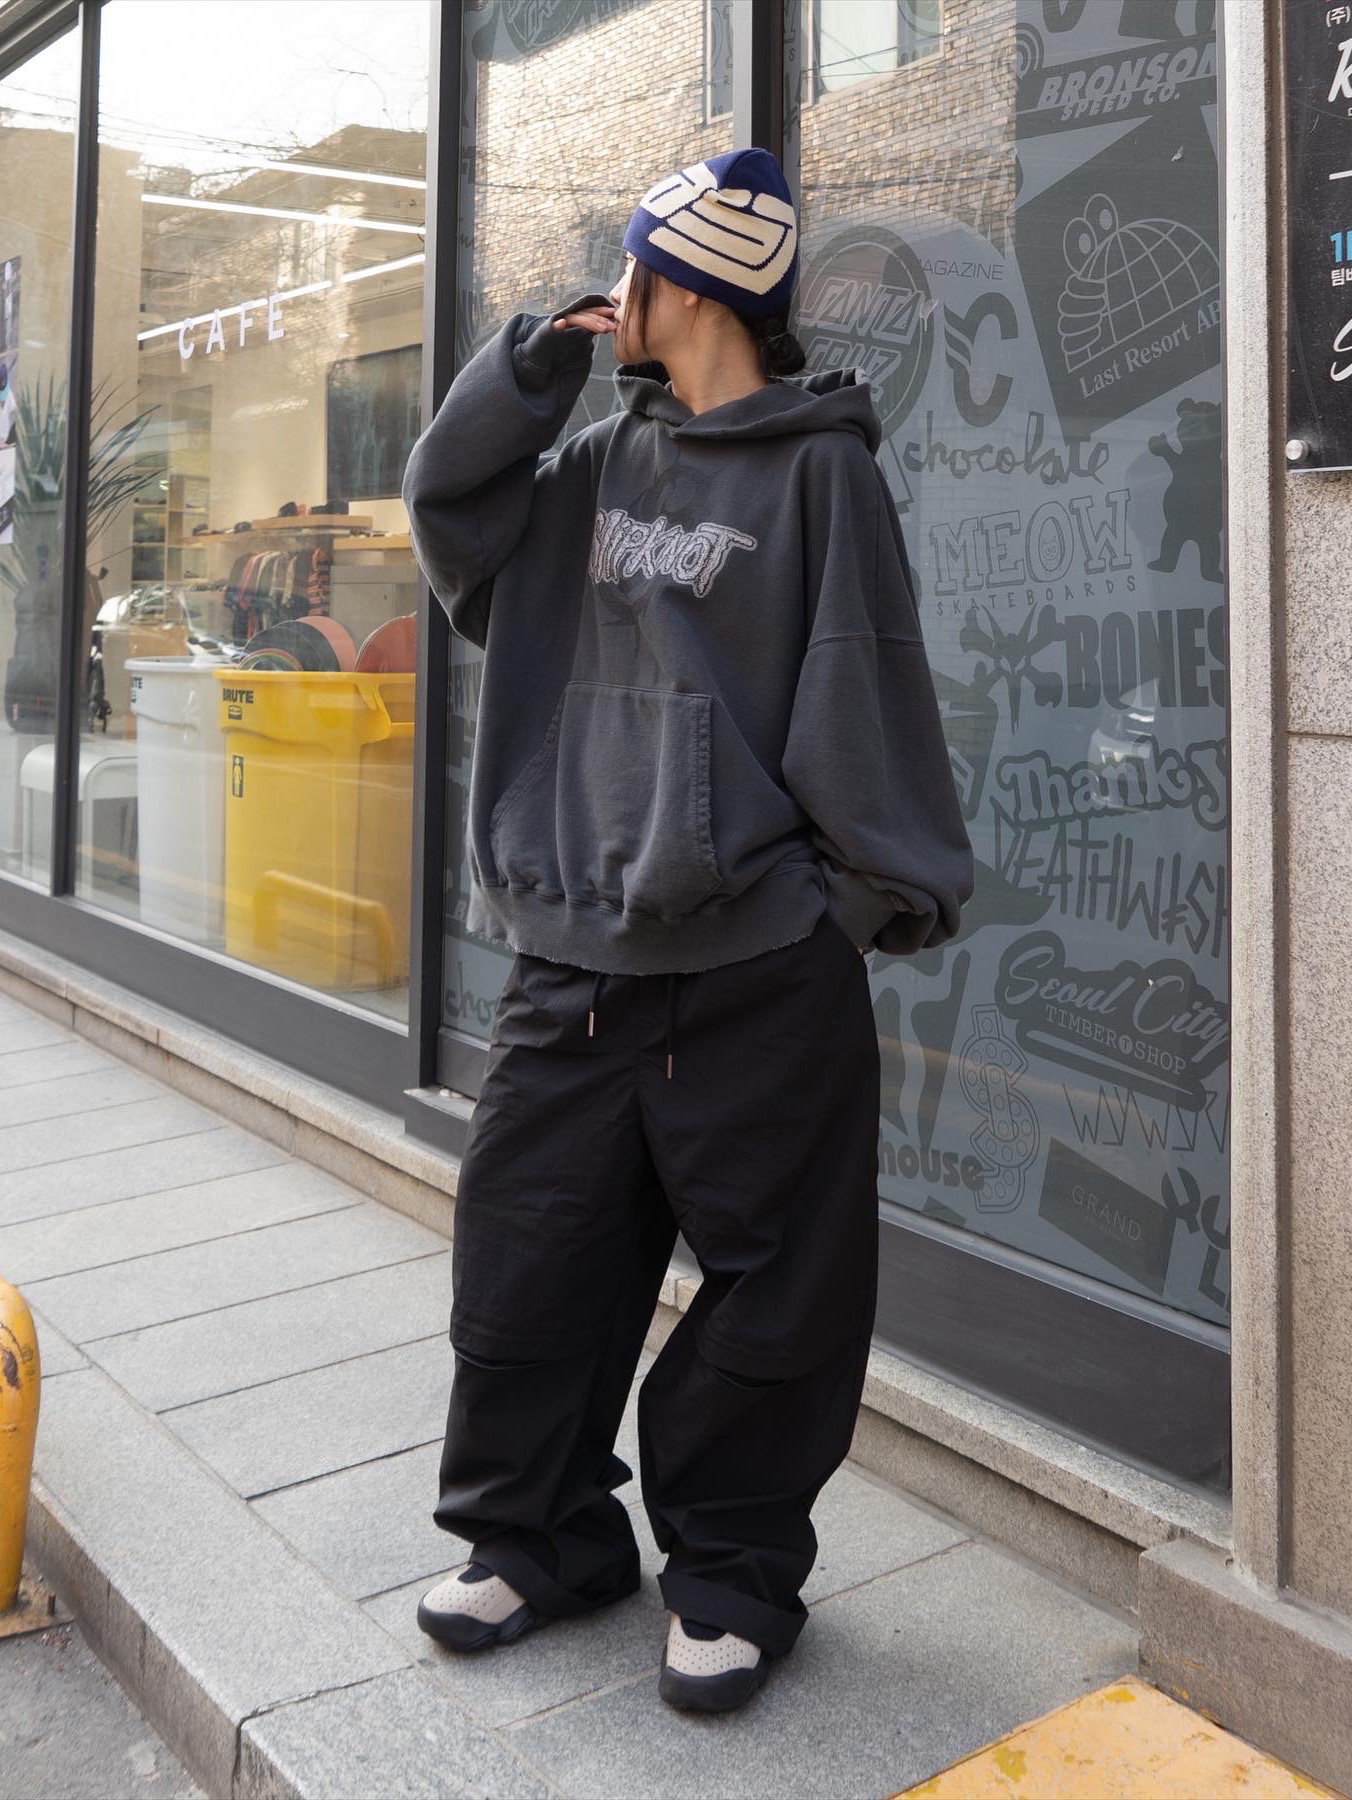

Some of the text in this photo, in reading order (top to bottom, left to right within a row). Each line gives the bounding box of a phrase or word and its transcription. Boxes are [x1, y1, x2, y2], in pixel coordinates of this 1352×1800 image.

[1061, 91, 1133, 121] SPEED
[918, 258, 1004, 280] AGAZINE
[178, 294, 285, 360] CAFE
[795, 277, 926, 345] SANTA
[1079, 360, 1122, 399] Last
[1125, 320, 1191, 373] Resort
[903, 411, 1109, 486] chocolate
[930, 488, 1132, 595] MEOW
[936, 575, 1137, 615] SKATEBOARDS
[223, 688, 254, 704] BRUTE
[1005, 946, 1228, 1063] Seoul City
[1072, 1185, 1141, 1240] GRAND
